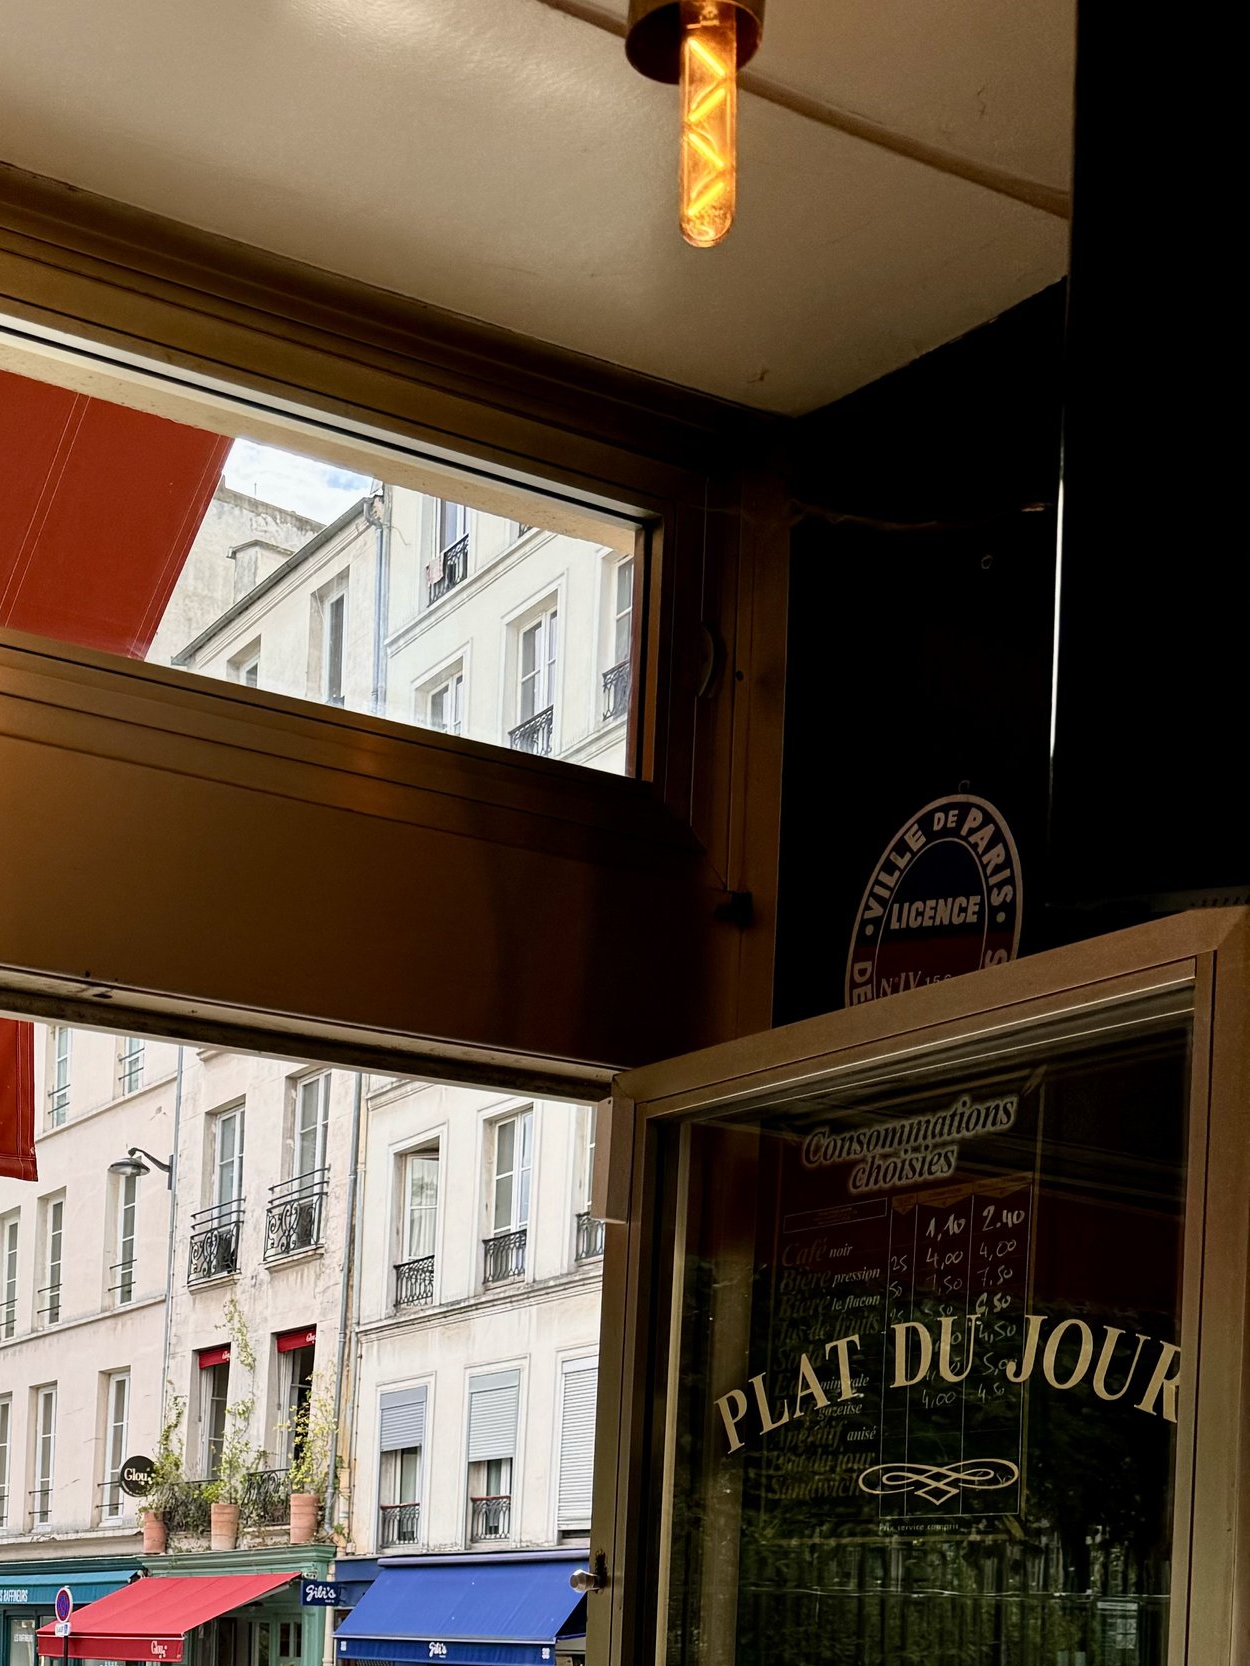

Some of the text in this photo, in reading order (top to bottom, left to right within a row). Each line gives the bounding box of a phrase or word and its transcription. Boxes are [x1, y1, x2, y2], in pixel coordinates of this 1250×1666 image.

[863, 807, 1013, 919] VILLE DE PARIS
[890, 895, 981, 930] LICENCE
[802, 1097, 1015, 1165] Consommations
[851, 1144, 956, 1189] choisies
[782, 1237, 853, 1267] Café noir
[925, 1246, 964, 1271] 4,00
[980, 1238, 1017, 1262] 4,00
[779, 1266, 881, 1294] Bière pression
[713, 1314, 1182, 1454] PLAT DU JOUR
[847, 1424, 878, 1442] anisé
